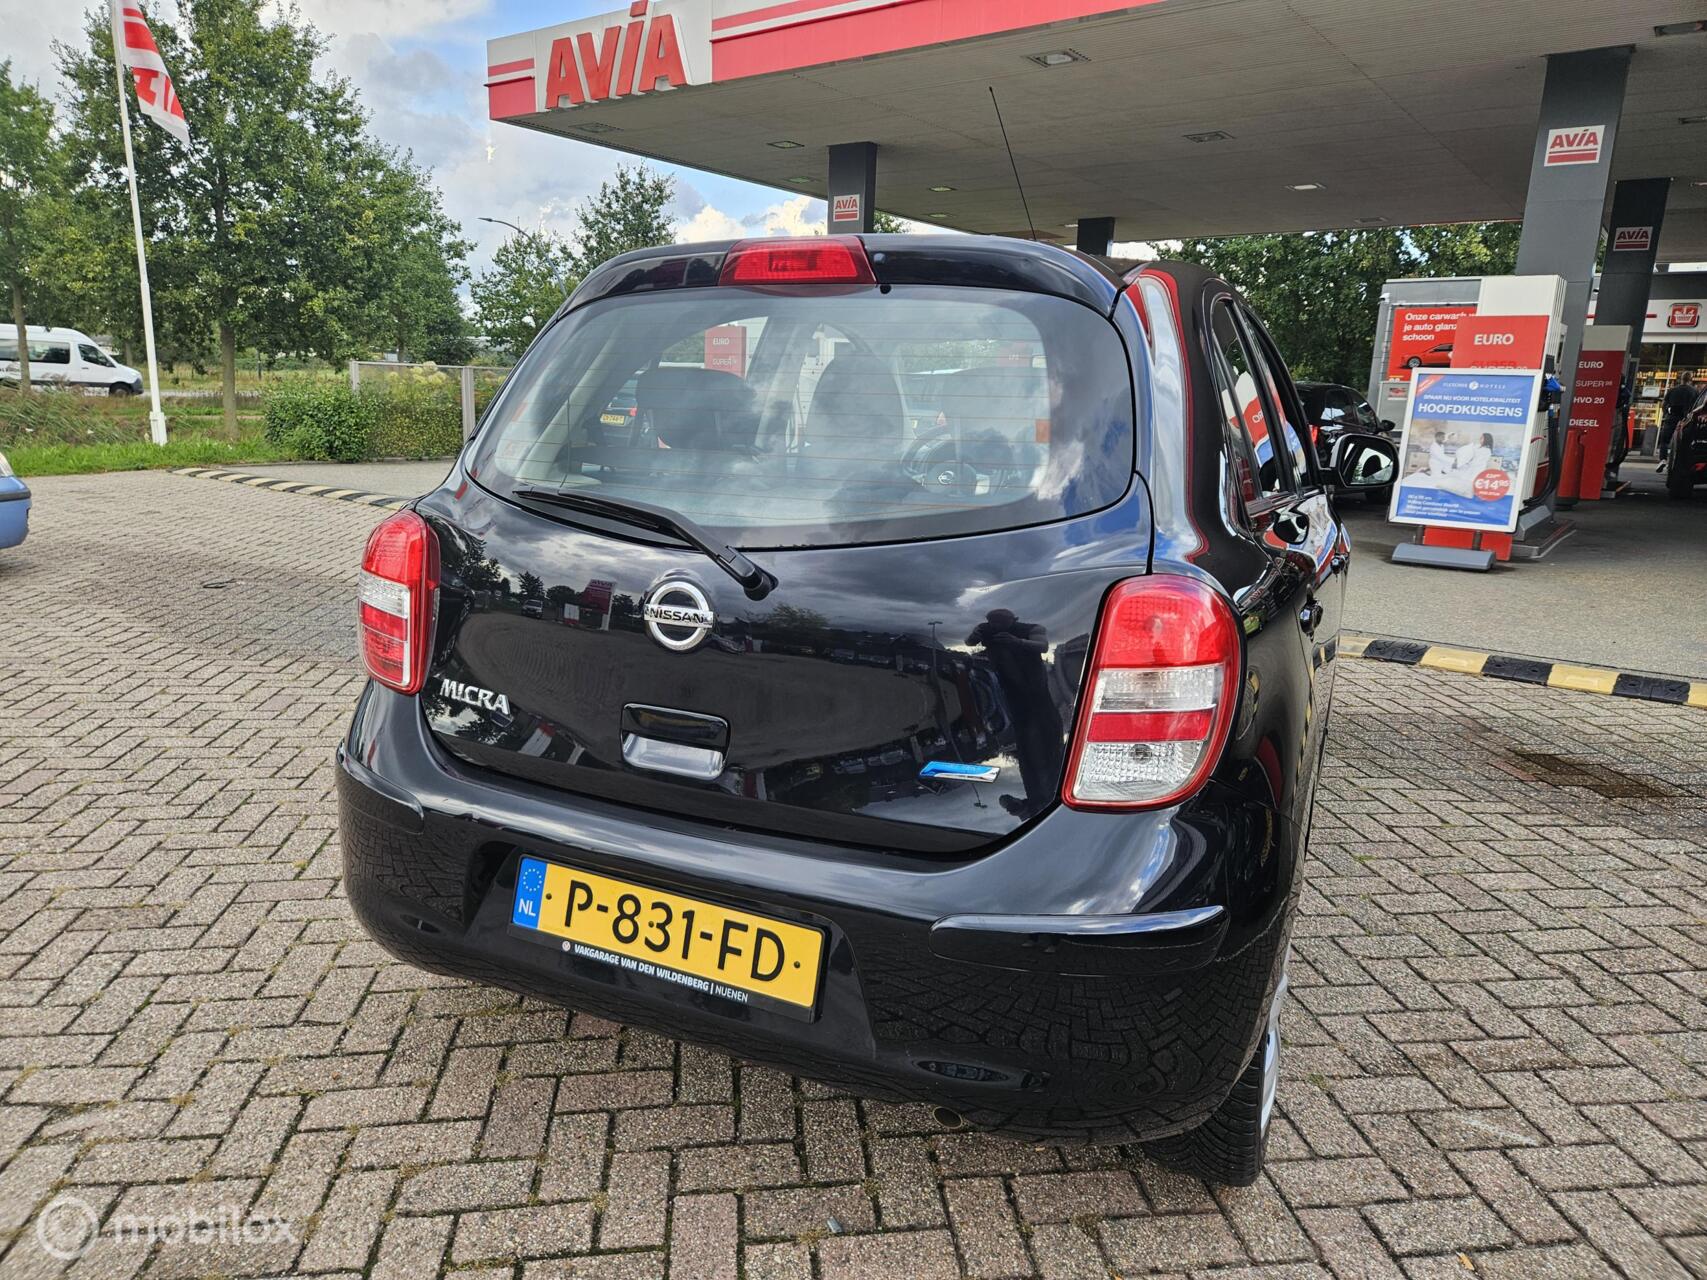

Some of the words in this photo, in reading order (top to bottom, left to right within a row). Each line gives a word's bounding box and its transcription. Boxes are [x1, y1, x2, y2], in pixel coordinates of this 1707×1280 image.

[1405, 312, 1428, 321] Onze
[1403, 323, 1413, 332] je
[1413, 323, 1433, 331] auto
[713, 337, 730, 346] EURO
[1402, 333, 1434, 341] schoon
[1474, 333, 1514, 345] EURO
[1578, 361, 1604, 369] EURO
[1576, 380, 1604, 388] SUPER
[1573, 396, 1592, 404] HVO
[1418, 403, 1522, 417] HOOFDKUSSENS
[1569, 418, 1600, 427] DIESEL
[649, 609, 704, 624] NISSAN
[440, 679, 511, 715] MICRA
[517, 898, 536, 917] NL
[564, 879, 786, 982] P-831-FD
[574, 943, 619, 965] VAKGARAGE
[620, 957, 637, 971] VAN
[638, 961, 655, 975] DEN
[656, 967, 709, 992] WILDENBERG
[715, 985, 749, 1003] NUENEN
